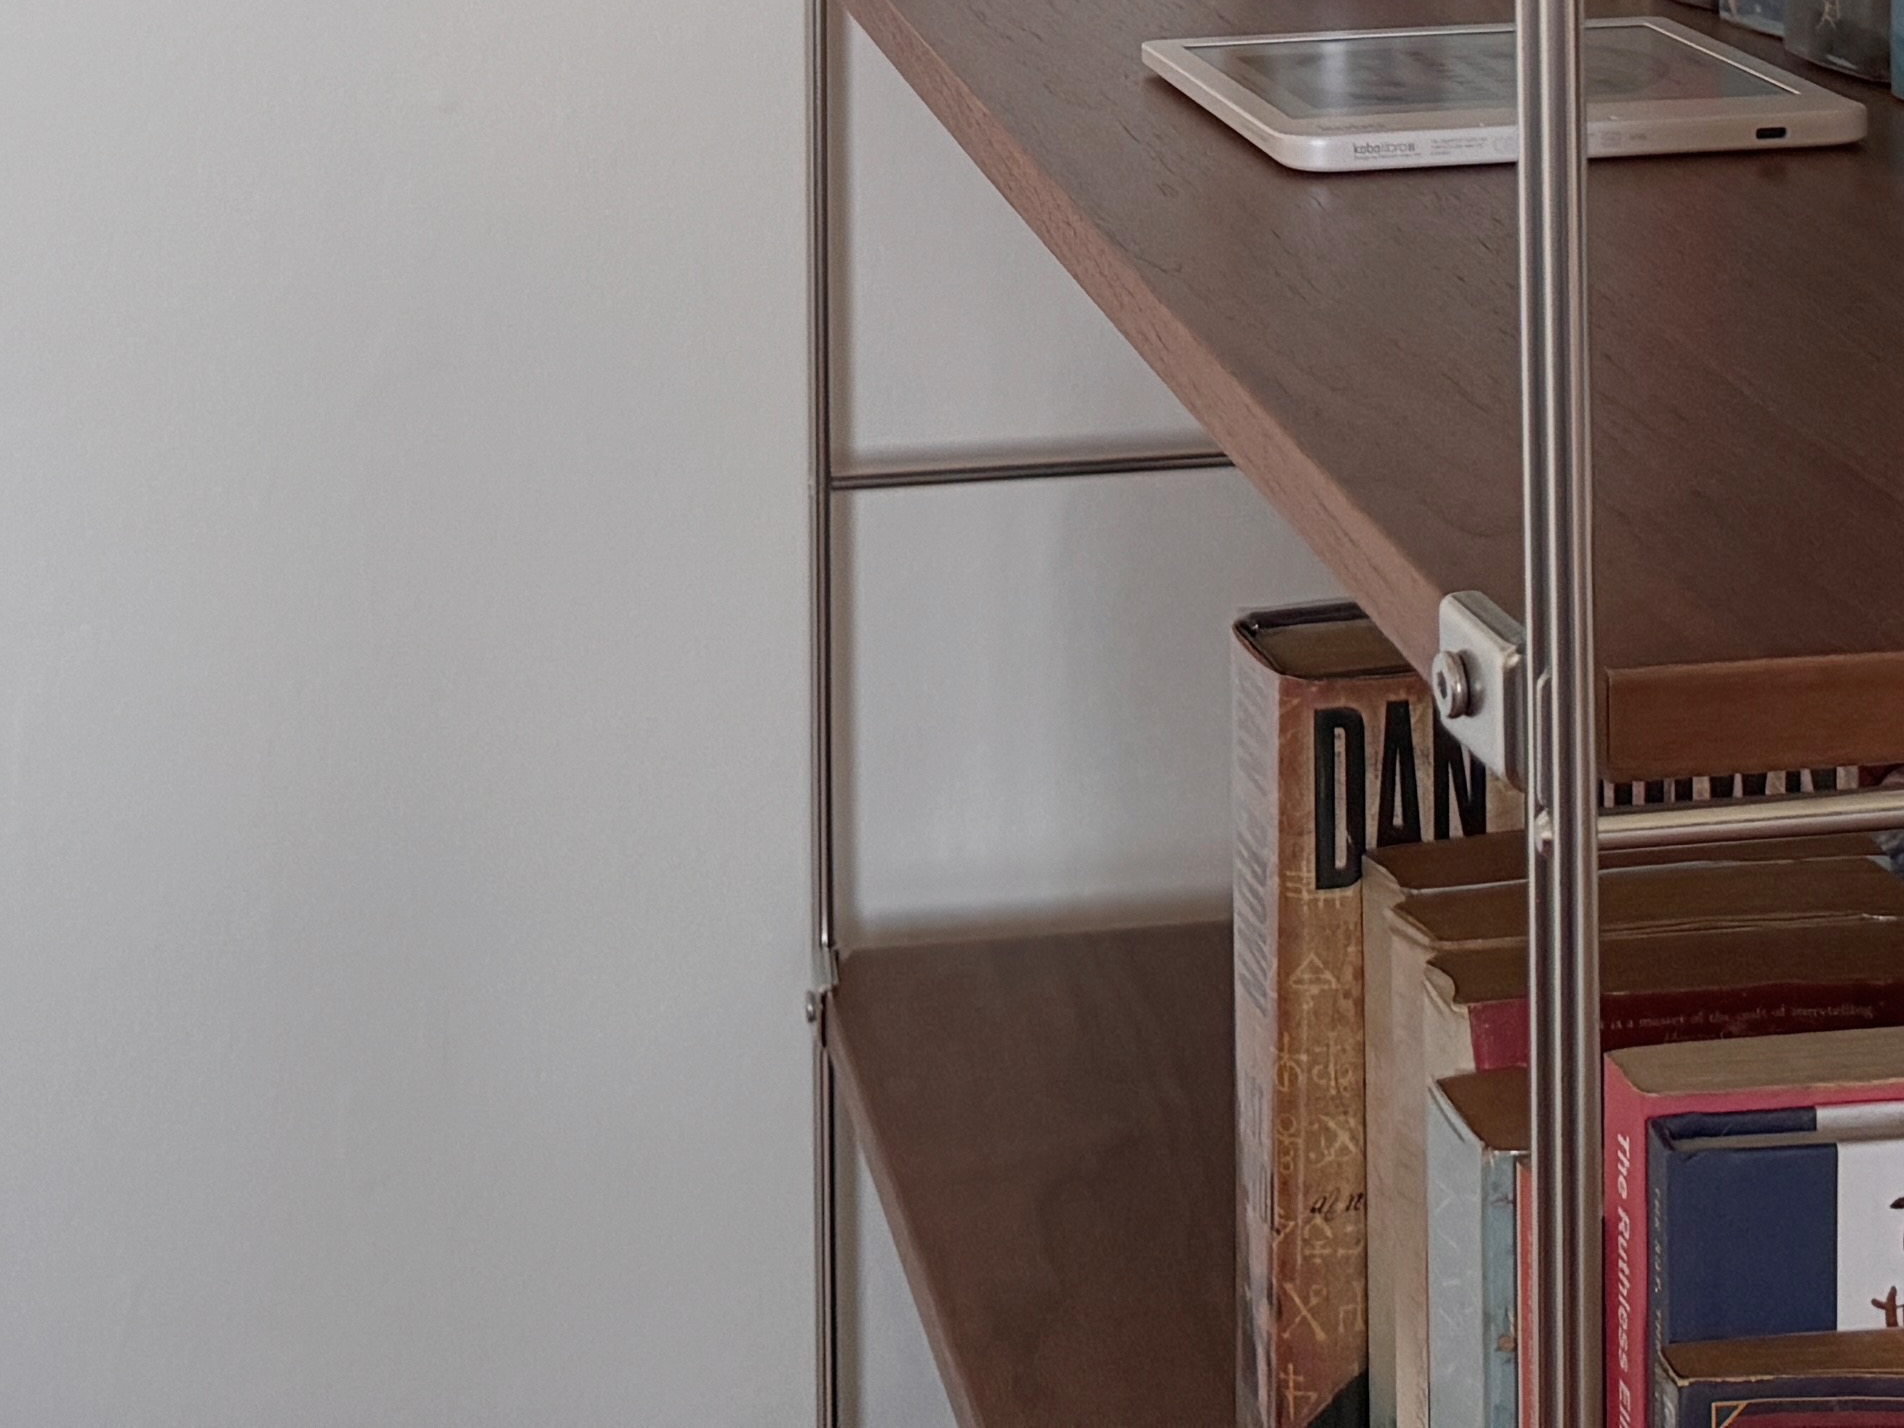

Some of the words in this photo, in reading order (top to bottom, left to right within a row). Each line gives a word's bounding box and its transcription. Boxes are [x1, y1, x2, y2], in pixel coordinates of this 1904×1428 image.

[1314, 700, 1487, 890] DAN
[1617, 1133, 1631, 1200] The
[1617, 1206, 1632, 1372] Ruthless
